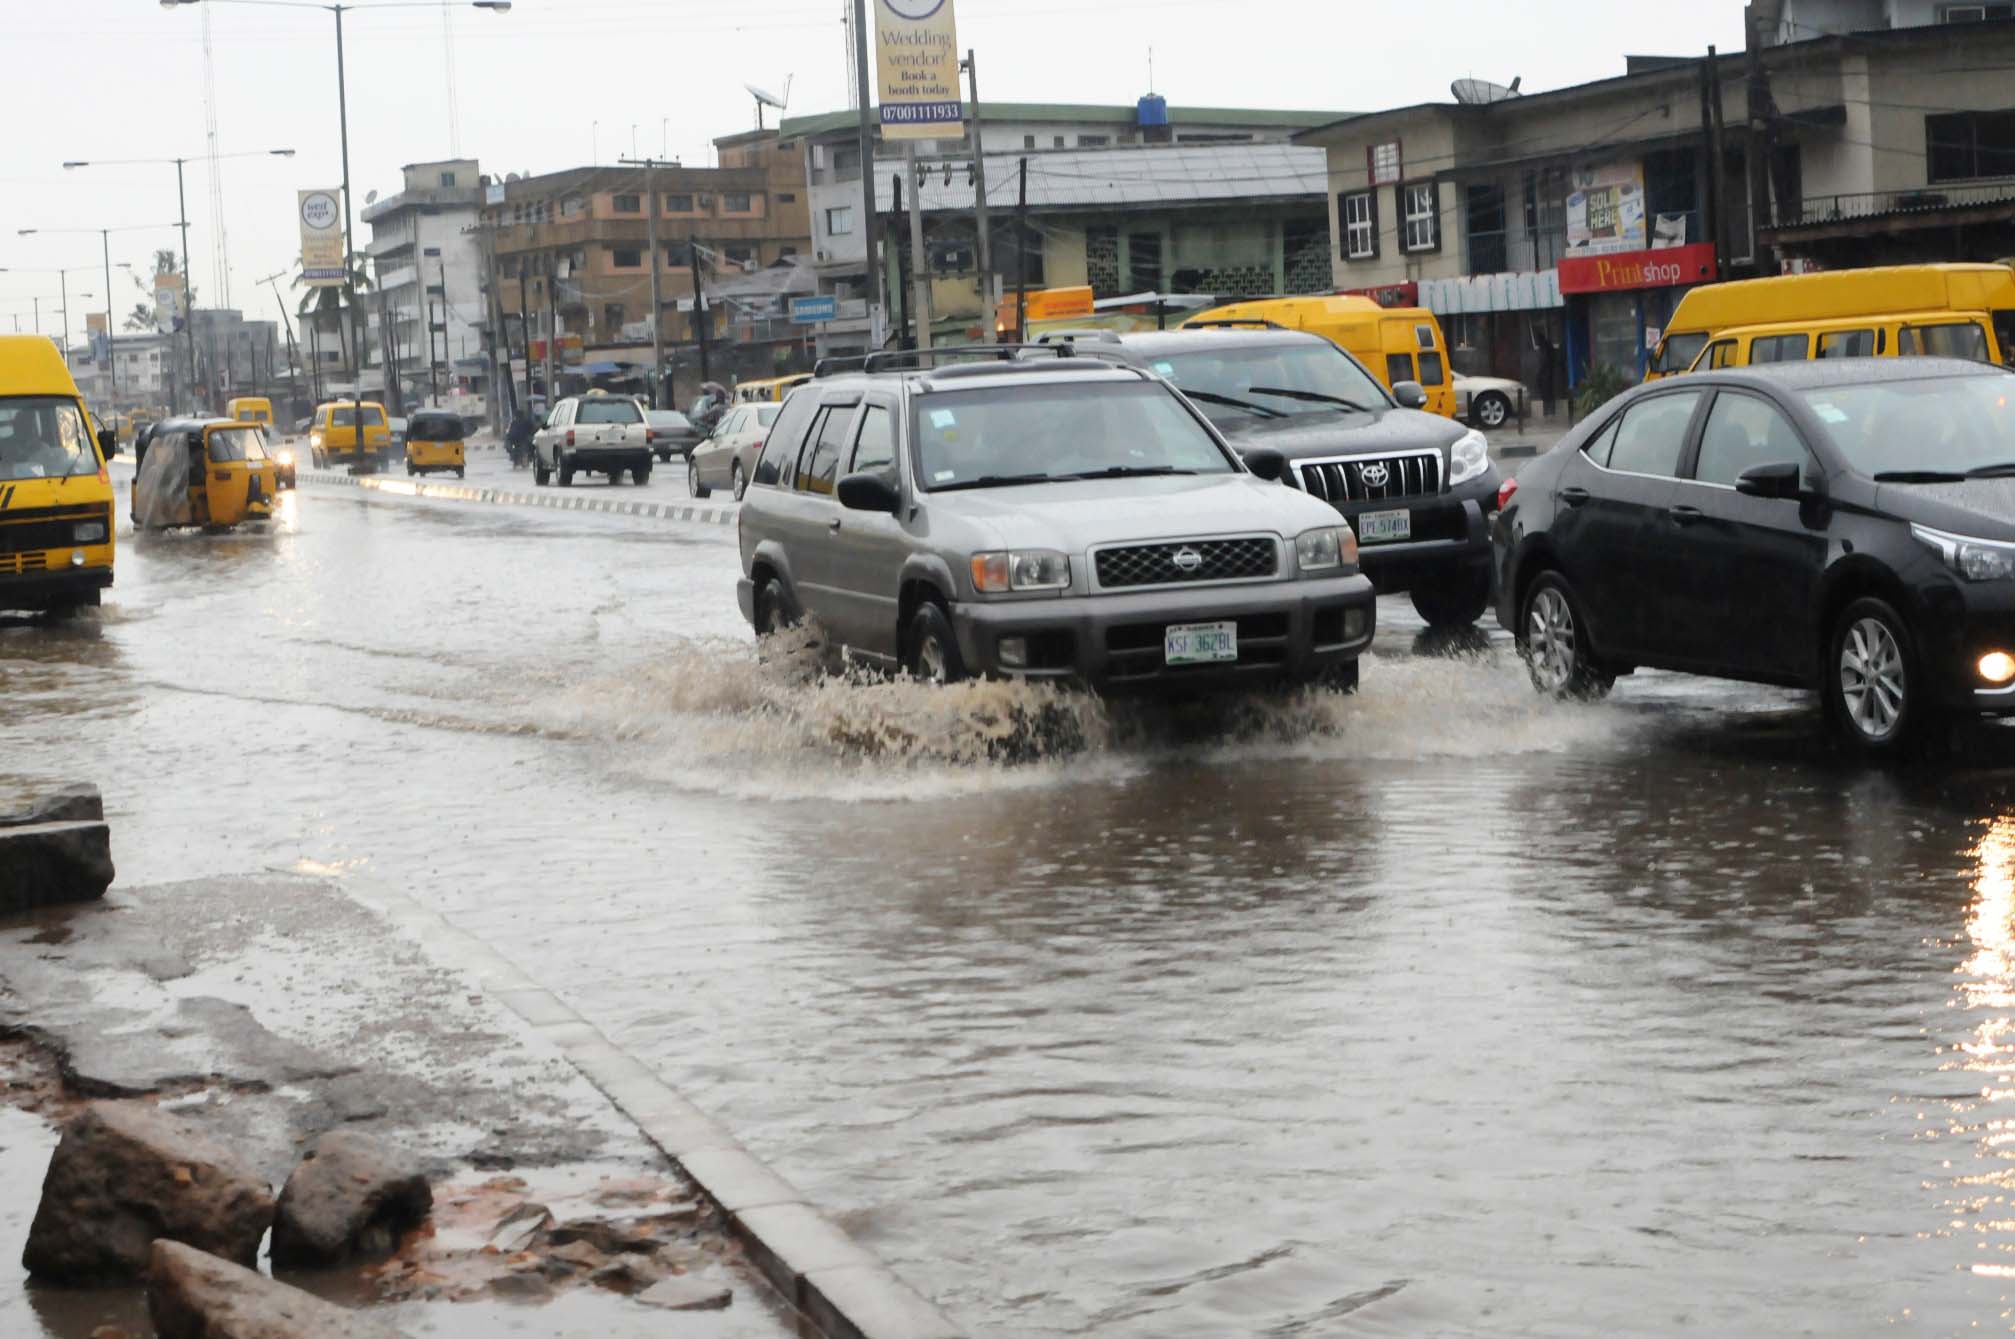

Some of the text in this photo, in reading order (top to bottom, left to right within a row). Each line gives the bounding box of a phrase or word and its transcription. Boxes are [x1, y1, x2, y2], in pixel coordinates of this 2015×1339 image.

[881, 29, 952, 48] Wedding
[901, 70, 928, 81] Book
[888, 83, 951, 96] booth today
[883, 104, 959, 120] 07001111933
